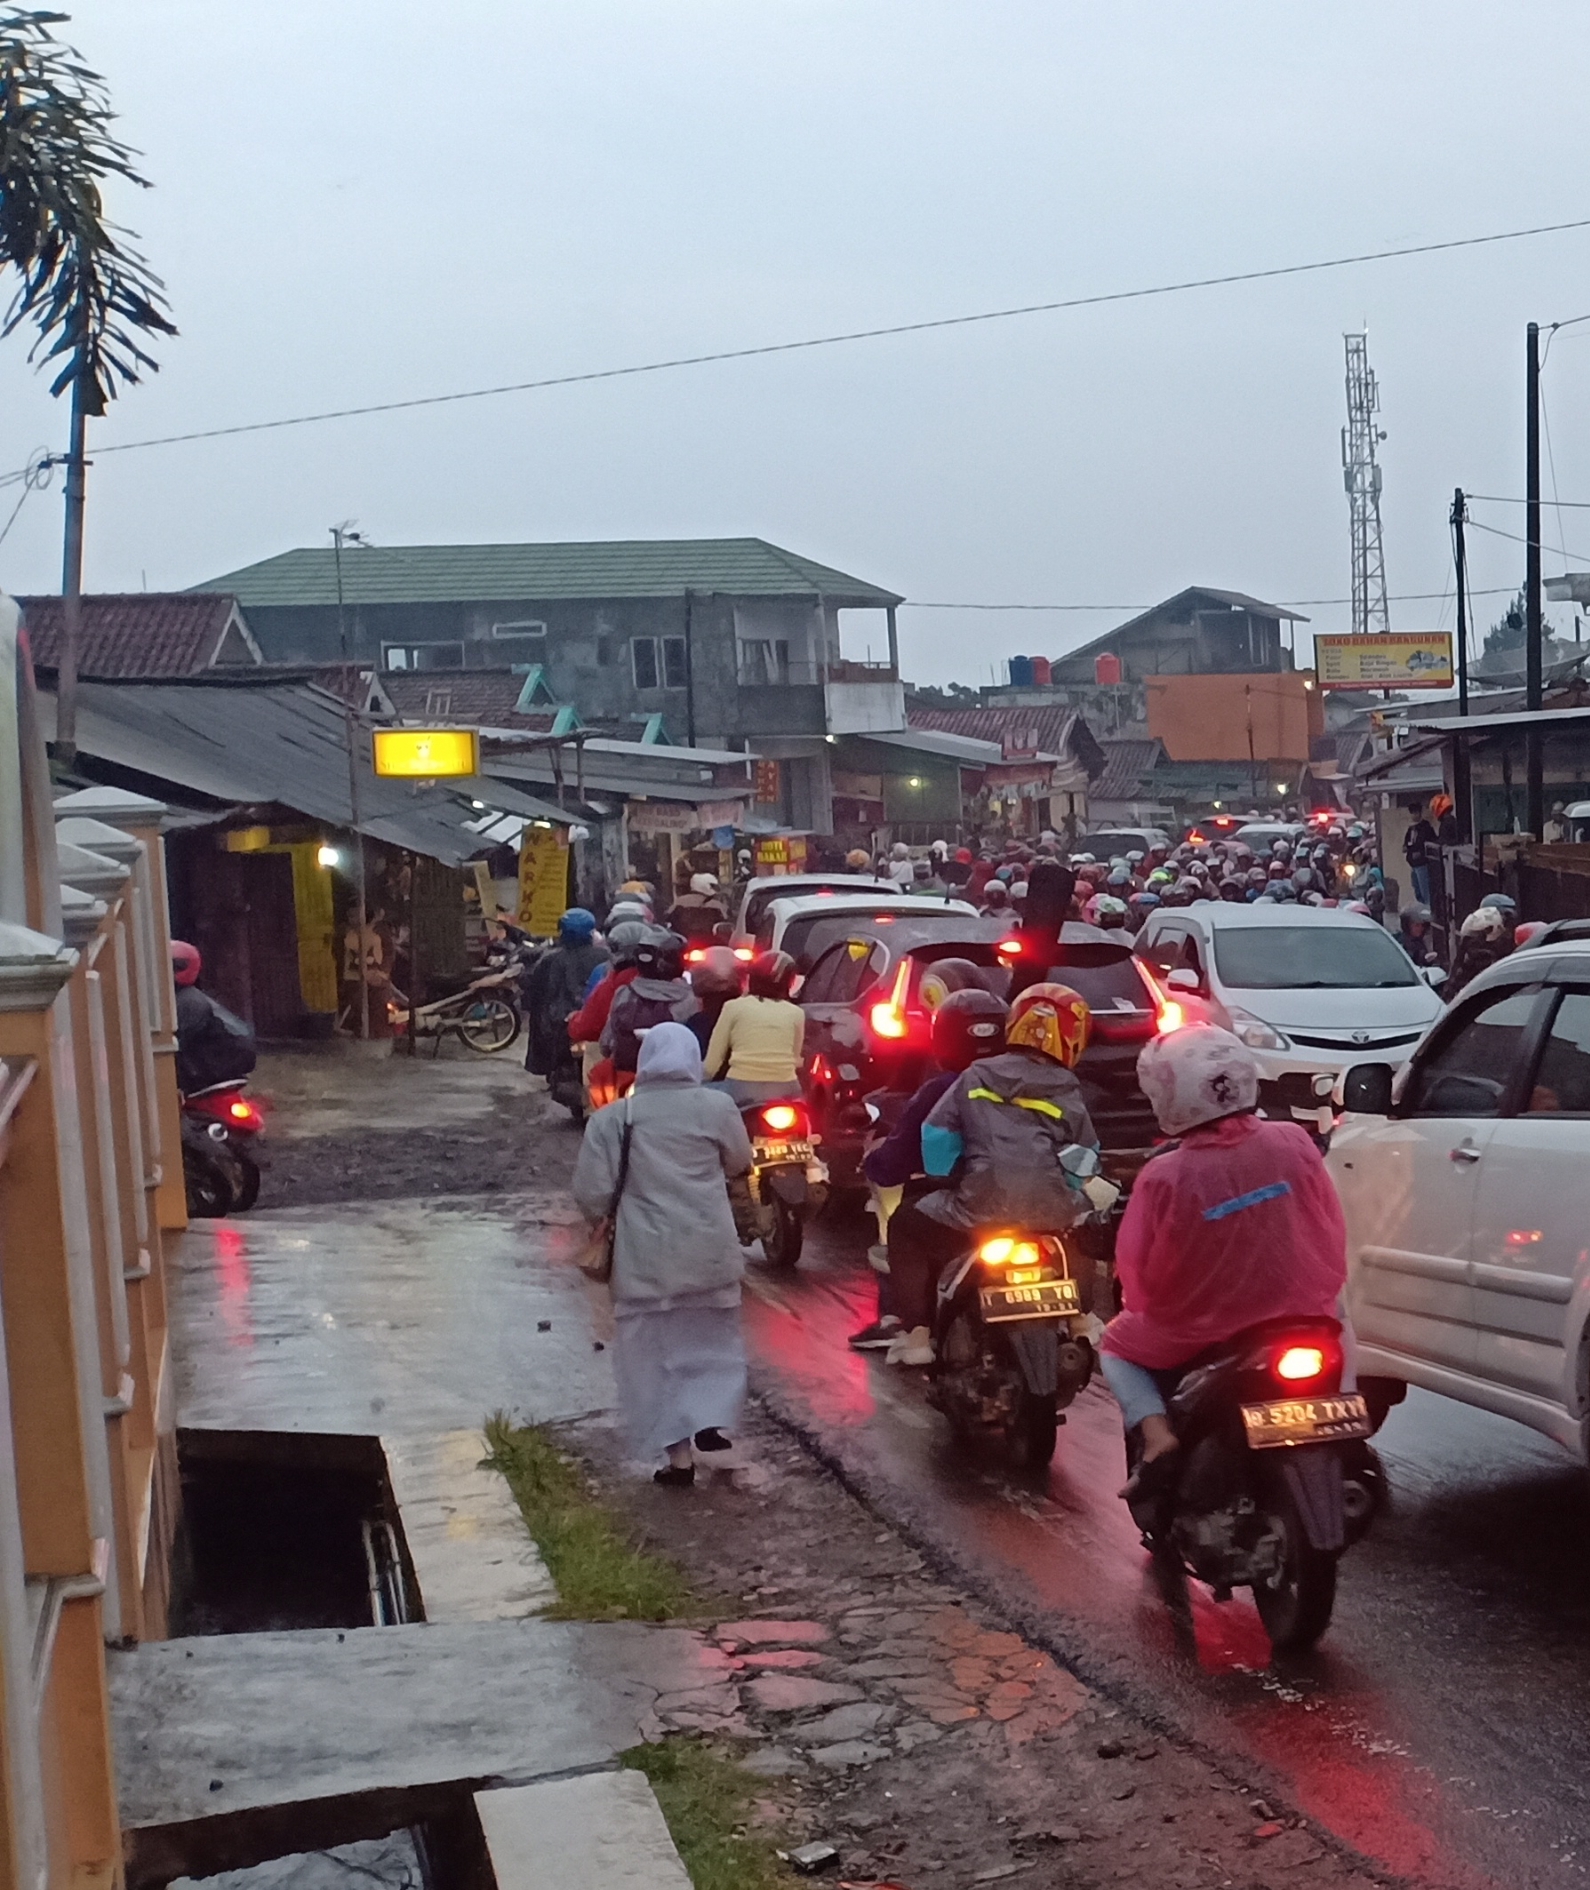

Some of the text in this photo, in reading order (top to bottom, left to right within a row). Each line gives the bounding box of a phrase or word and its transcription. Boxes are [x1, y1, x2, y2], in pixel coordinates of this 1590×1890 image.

[1352, 636, 1388, 646] BAHAN
[1389, 635, 1446, 645] BANGUNAN
[761, 840, 783, 851] ROTI
[757, 851, 788, 862] BAKAR
